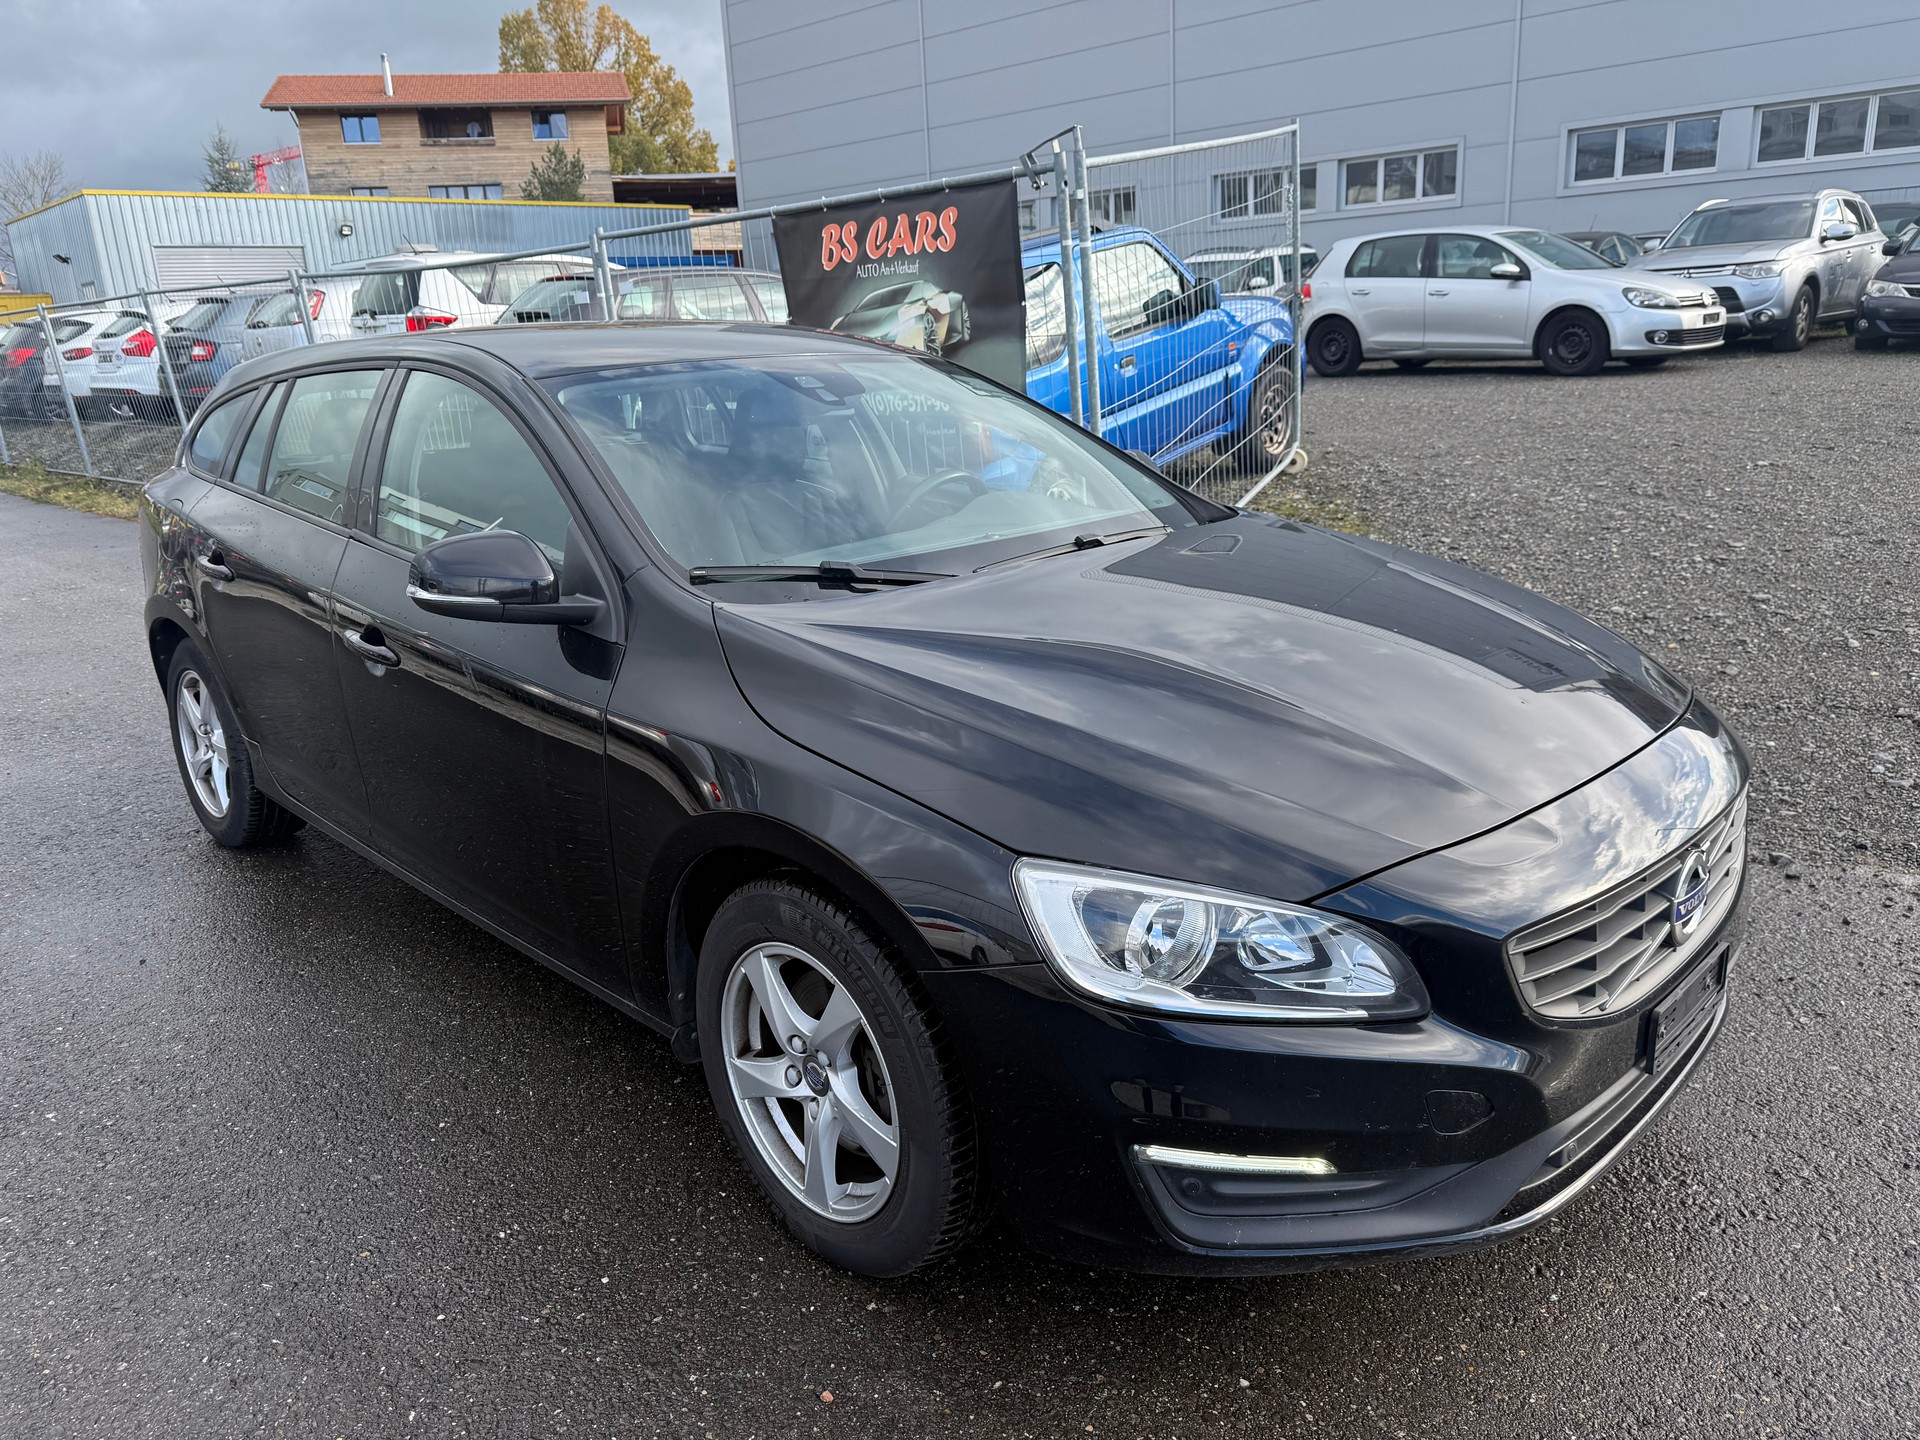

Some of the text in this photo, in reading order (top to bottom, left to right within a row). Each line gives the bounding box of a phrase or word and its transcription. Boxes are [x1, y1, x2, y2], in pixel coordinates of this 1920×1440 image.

[822, 206, 958, 271] BS CARS
[856, 263, 879, 279] AUTO
[815, 930, 895, 1033] MICHELIN
